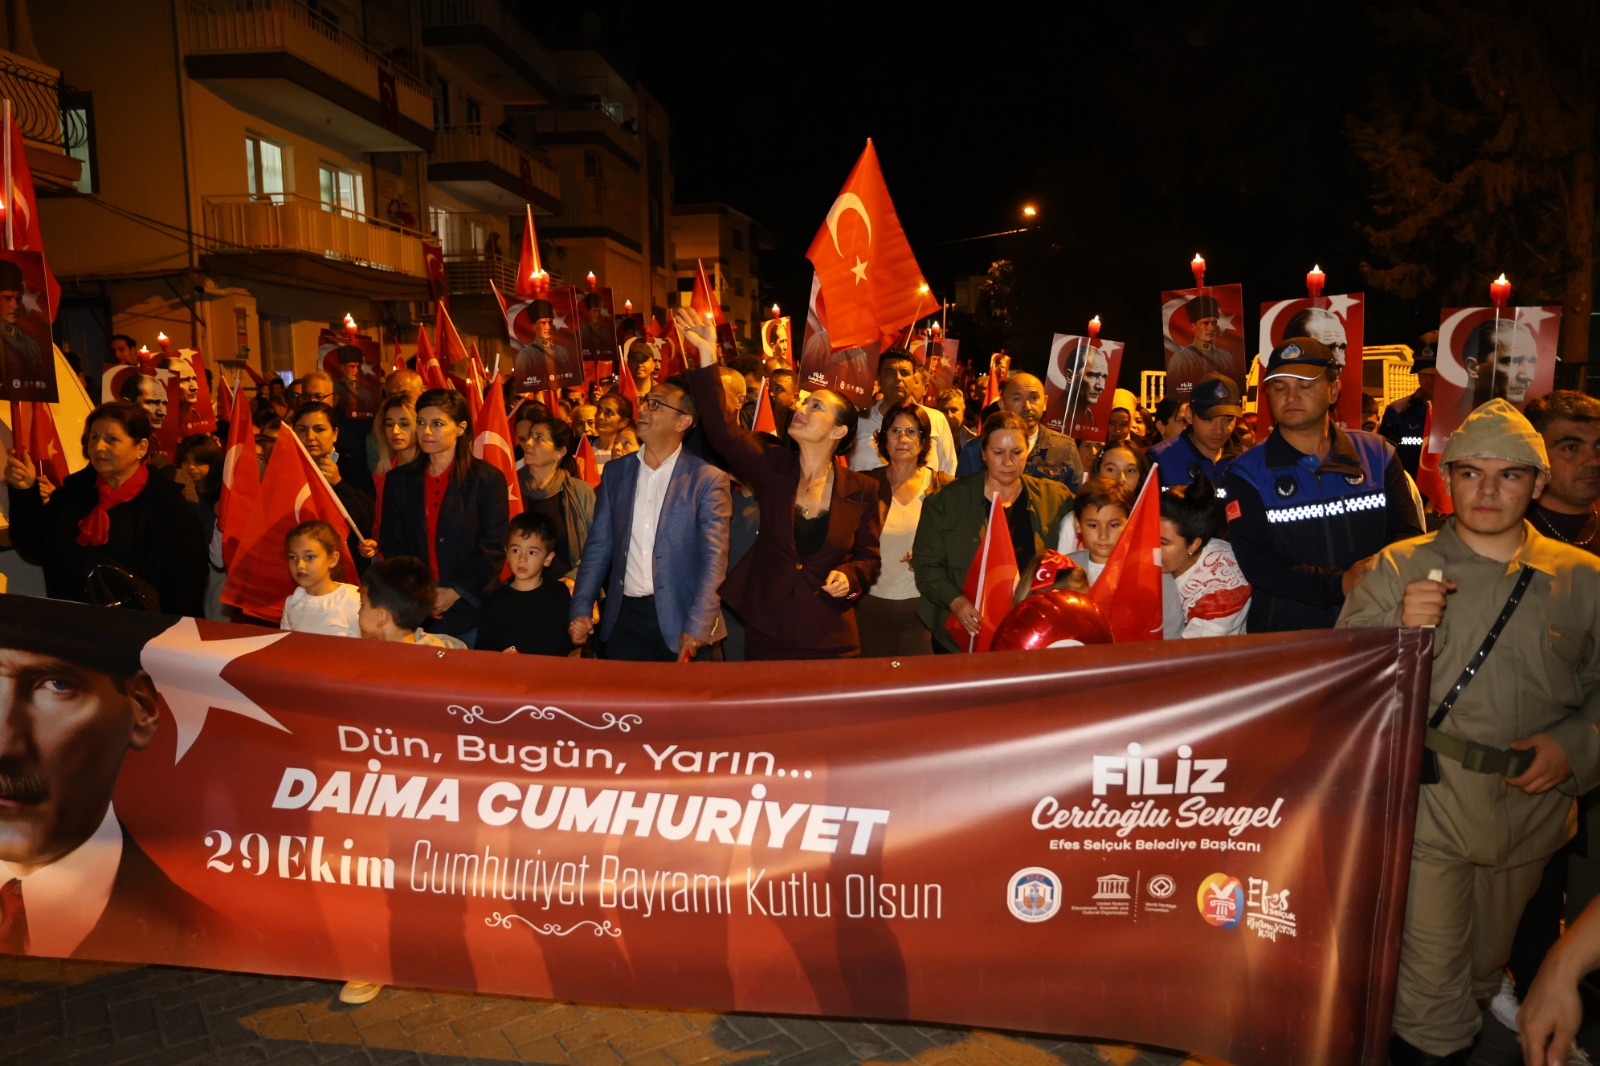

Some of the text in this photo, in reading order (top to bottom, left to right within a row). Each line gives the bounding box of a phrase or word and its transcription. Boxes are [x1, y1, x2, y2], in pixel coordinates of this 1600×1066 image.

[337, 725, 814, 780] Dün, Bugün, Yarın...
[1092, 742, 1228, 796] FİLİZ
[271, 758, 891, 856] DAİMA CUMHURİYET
[1030, 795, 1171, 838] Ceritoğlu
[1049, 838, 1261, 852] Efes Selçuk Belediye Başkanı
[409, 839, 589, 911] Cumhuriyet
[600, 854, 732, 918] Bayramı
[746, 867, 832, 918] Kutlu
[845, 873, 943, 920] Olsun
